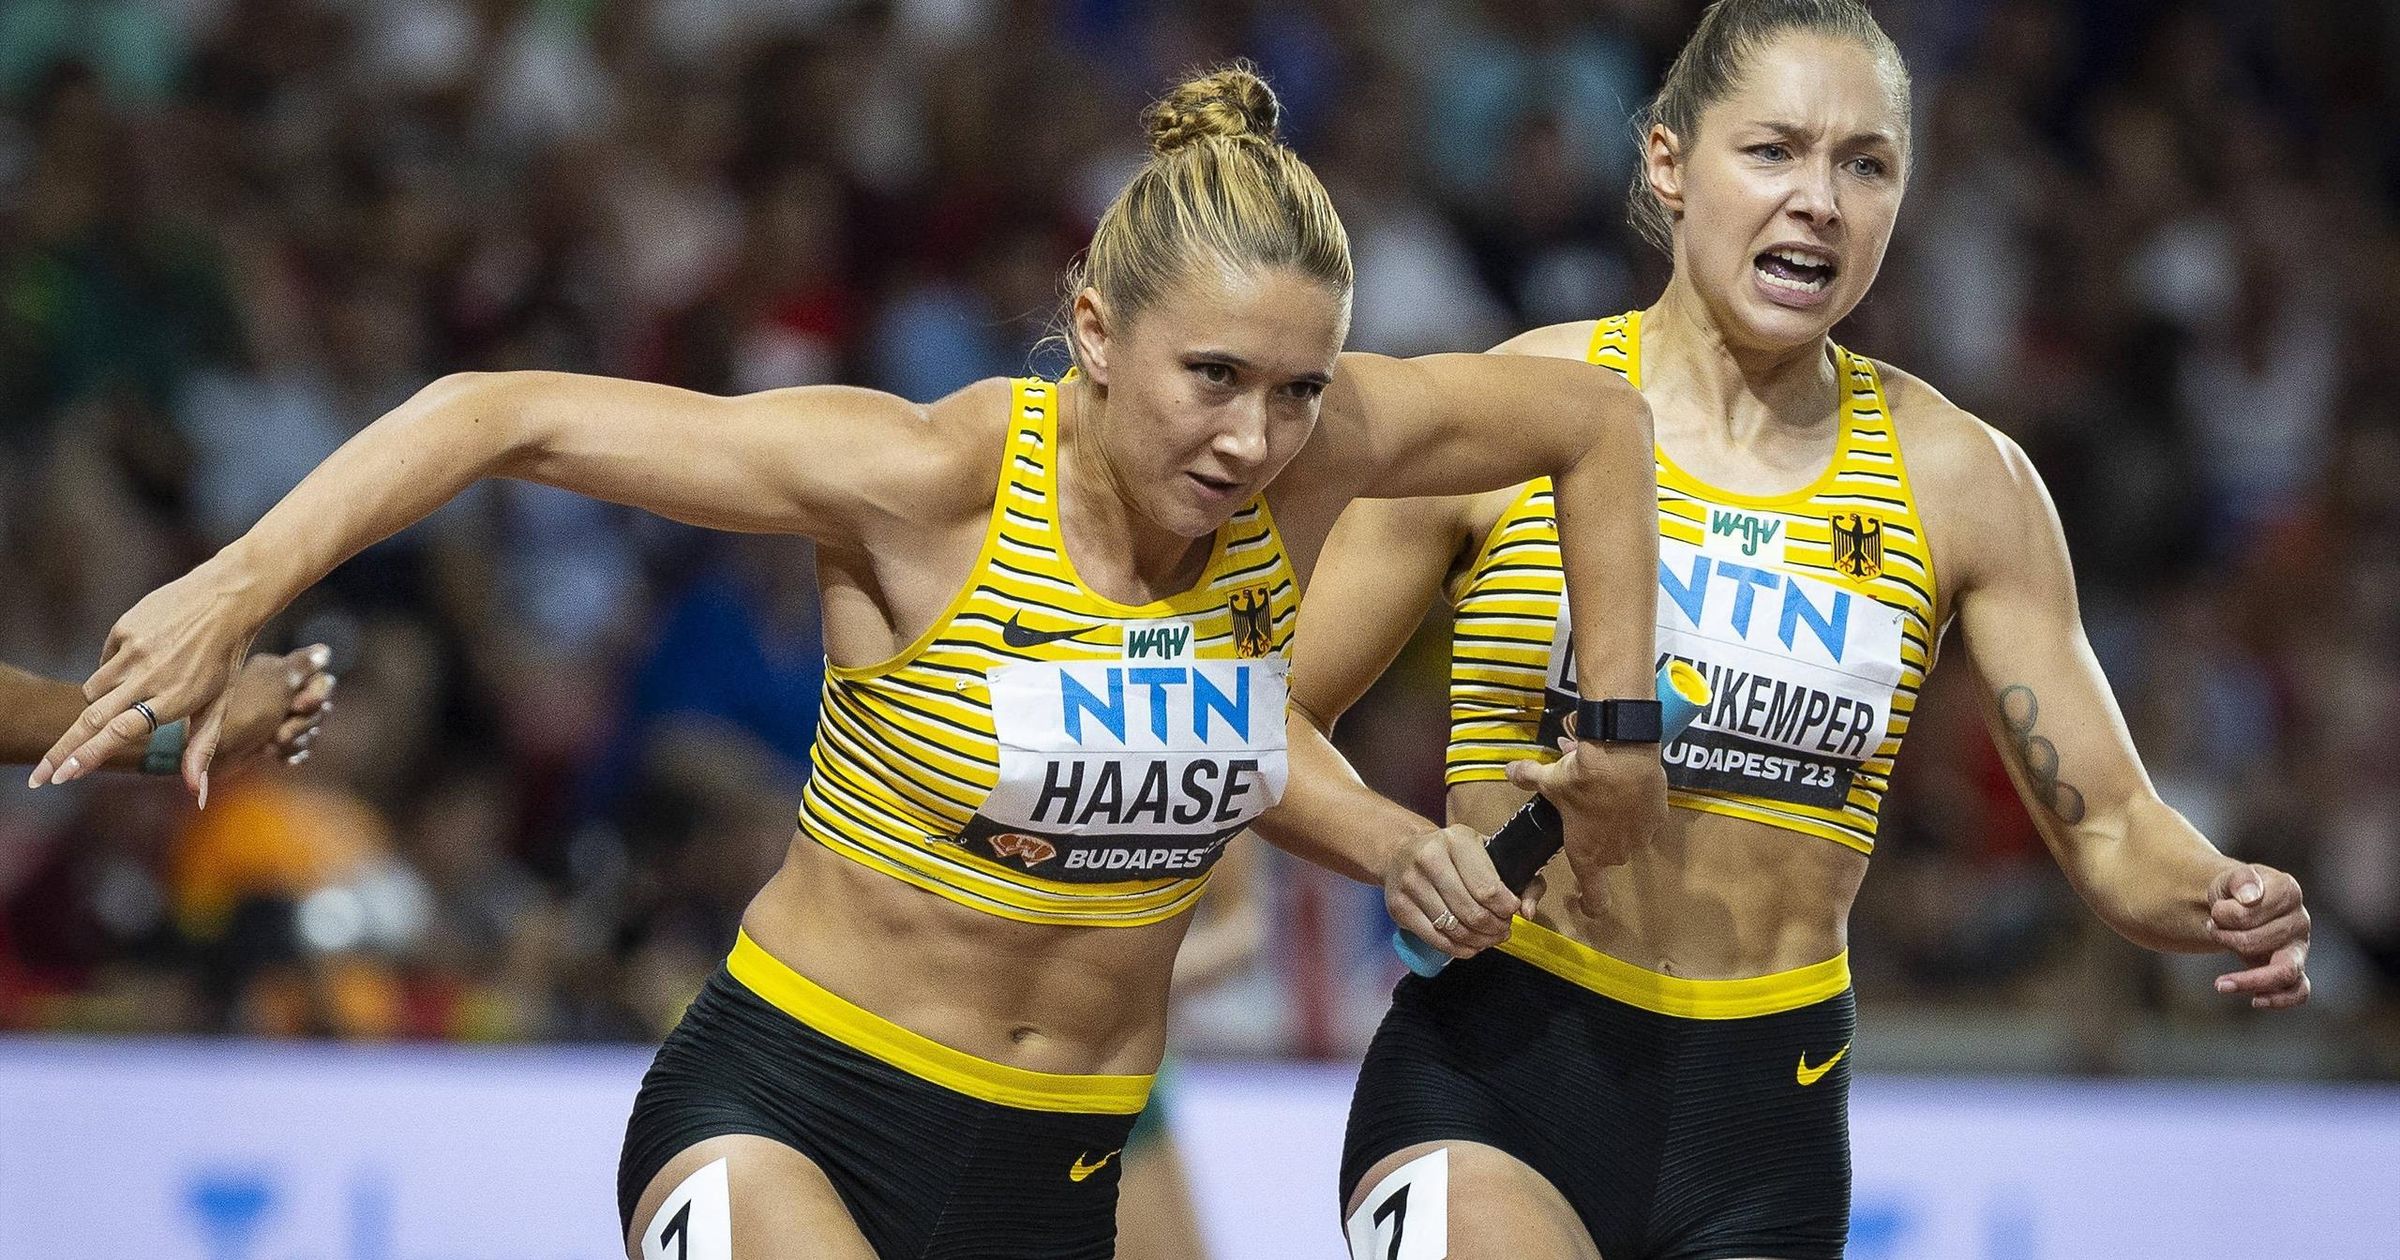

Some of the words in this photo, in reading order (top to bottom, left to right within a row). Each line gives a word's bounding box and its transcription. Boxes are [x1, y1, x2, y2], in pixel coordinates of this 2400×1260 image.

[1657, 554, 1850, 664] NTN
[1060, 666, 1250, 746] NTN
[1029, 759, 1259, 825] HAASE
[1662, 739, 1798, 785] UDAPEST
[1801, 763, 1835, 788] 23
[1064, 848, 1211, 870] BUDAPES
